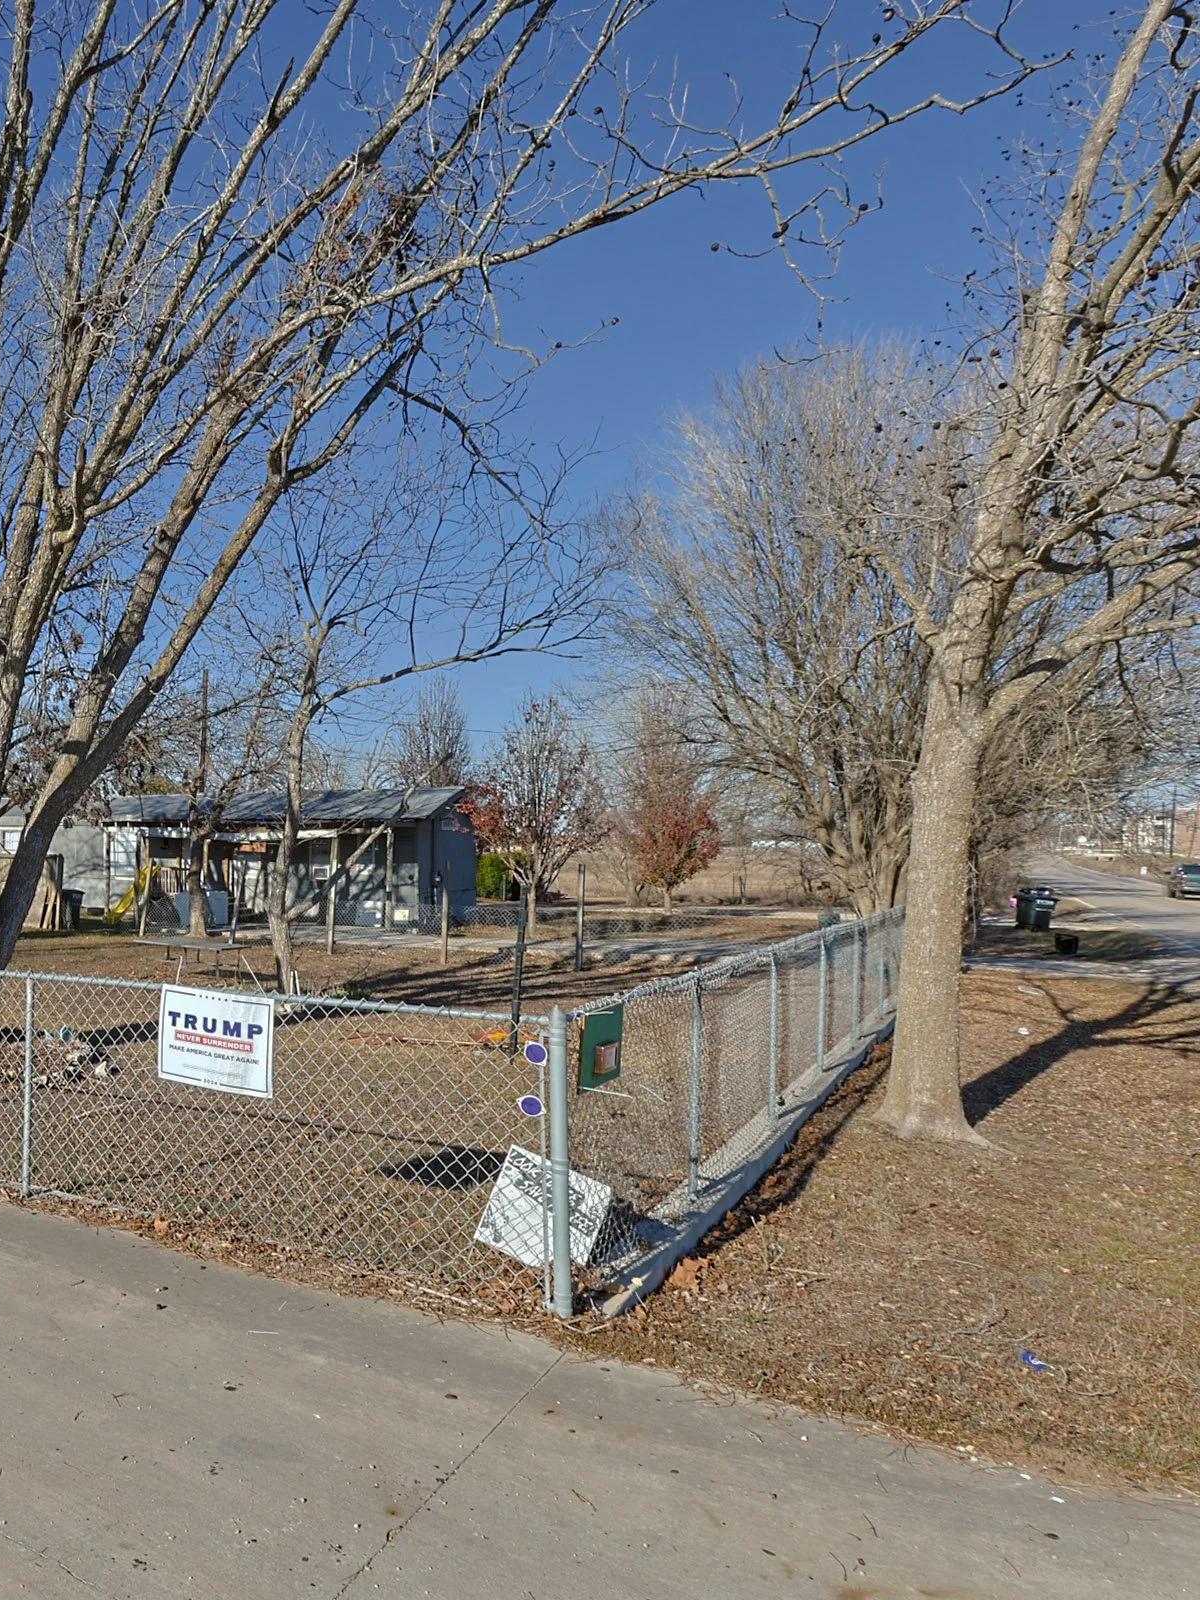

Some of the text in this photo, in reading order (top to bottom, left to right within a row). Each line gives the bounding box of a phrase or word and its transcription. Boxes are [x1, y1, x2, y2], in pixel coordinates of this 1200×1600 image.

[168, 1010, 263, 1039] TRUMP
[176, 1033, 251, 1051] NEVER SURRENDER
[169, 1044, 260, 1065] MAKE AMERICA GREAT AGAIN!
[203, 1078, 218, 1086] 2024
[507, 1150, 542, 1178] LOOK
